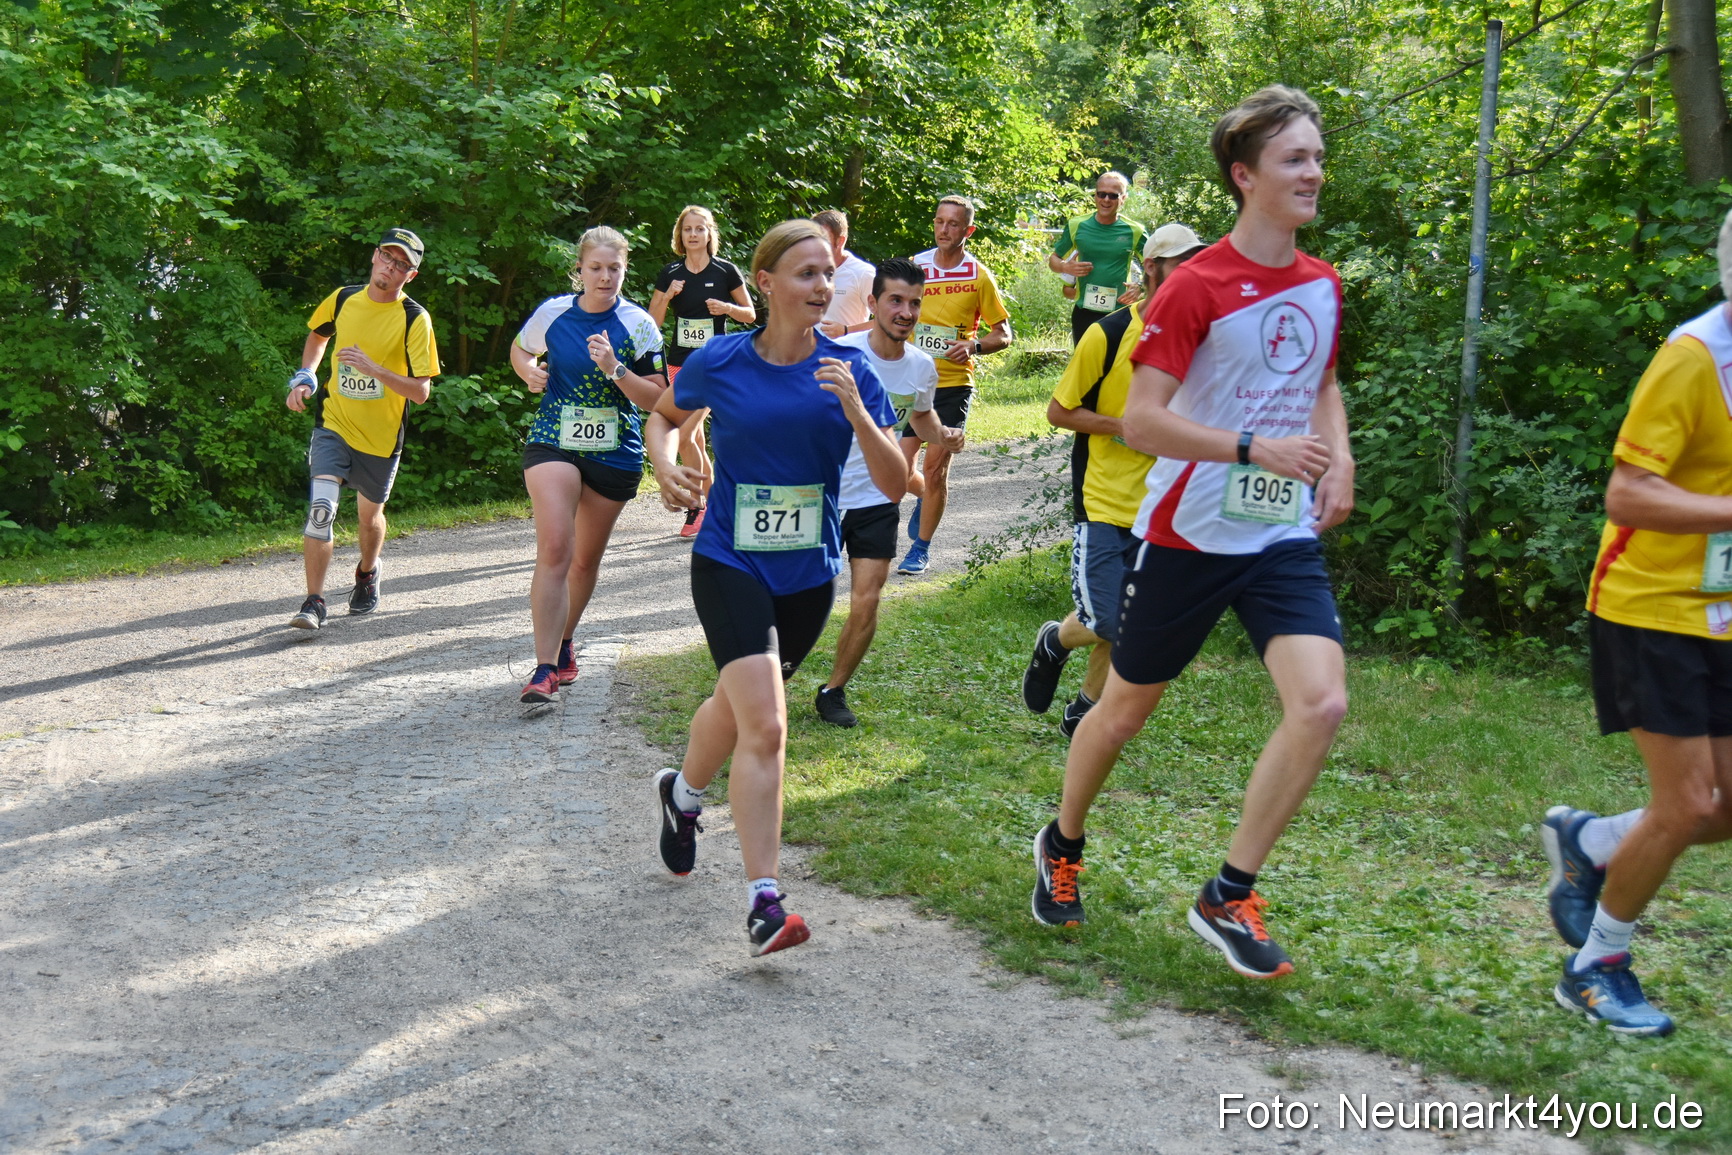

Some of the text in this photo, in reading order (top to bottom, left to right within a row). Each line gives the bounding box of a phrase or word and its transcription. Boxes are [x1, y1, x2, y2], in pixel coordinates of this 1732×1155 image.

[923, 283, 978, 297] AX BÖGL
[1094, 294, 1106, 305] 15
[683, 329, 705, 340] 948
[341, 375, 377, 391] 2004
[1282, 387, 1300, 398] MIT
[572, 423, 606, 439] 208
[1238, 474, 1293, 505] 1905
[754, 509, 800, 533] 871
[753, 533, 779, 541] Stepper
